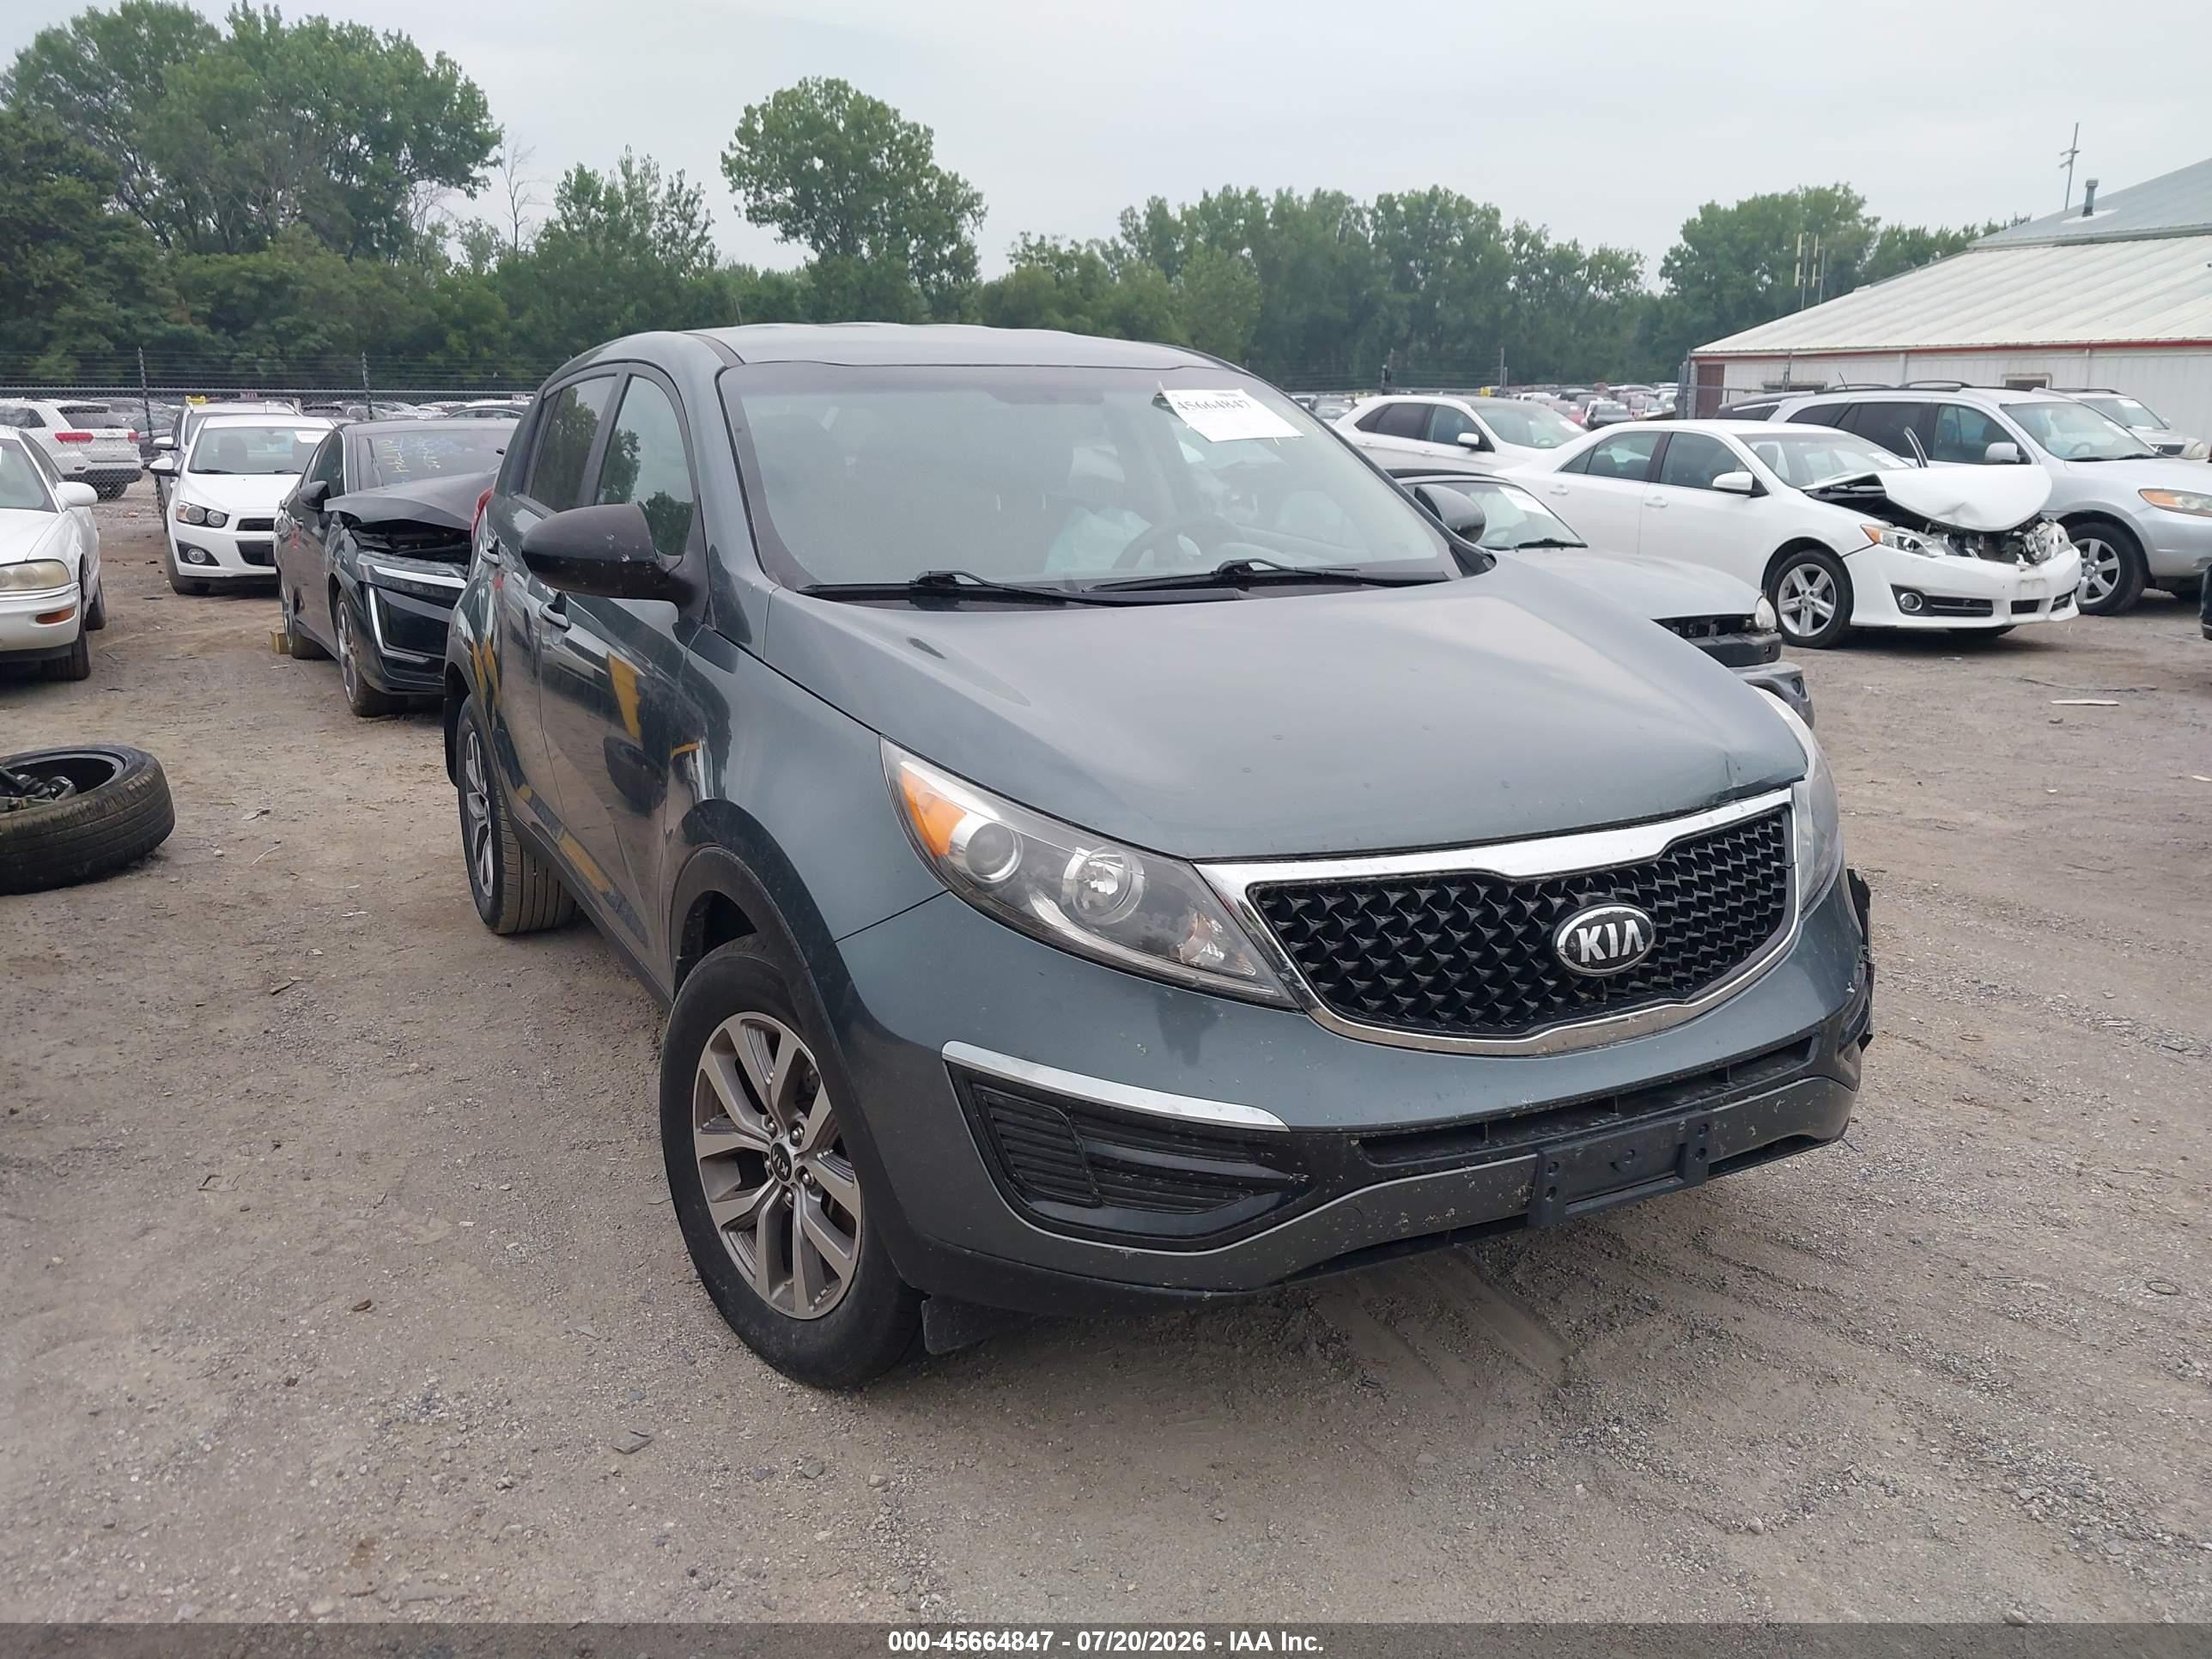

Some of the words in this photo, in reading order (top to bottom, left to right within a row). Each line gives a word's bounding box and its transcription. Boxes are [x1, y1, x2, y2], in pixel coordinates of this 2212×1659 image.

[1177, 399, 1251, 410] 45664847
[1577, 921, 1645, 963] KIA
[772, 1148, 788, 1176] KIA
